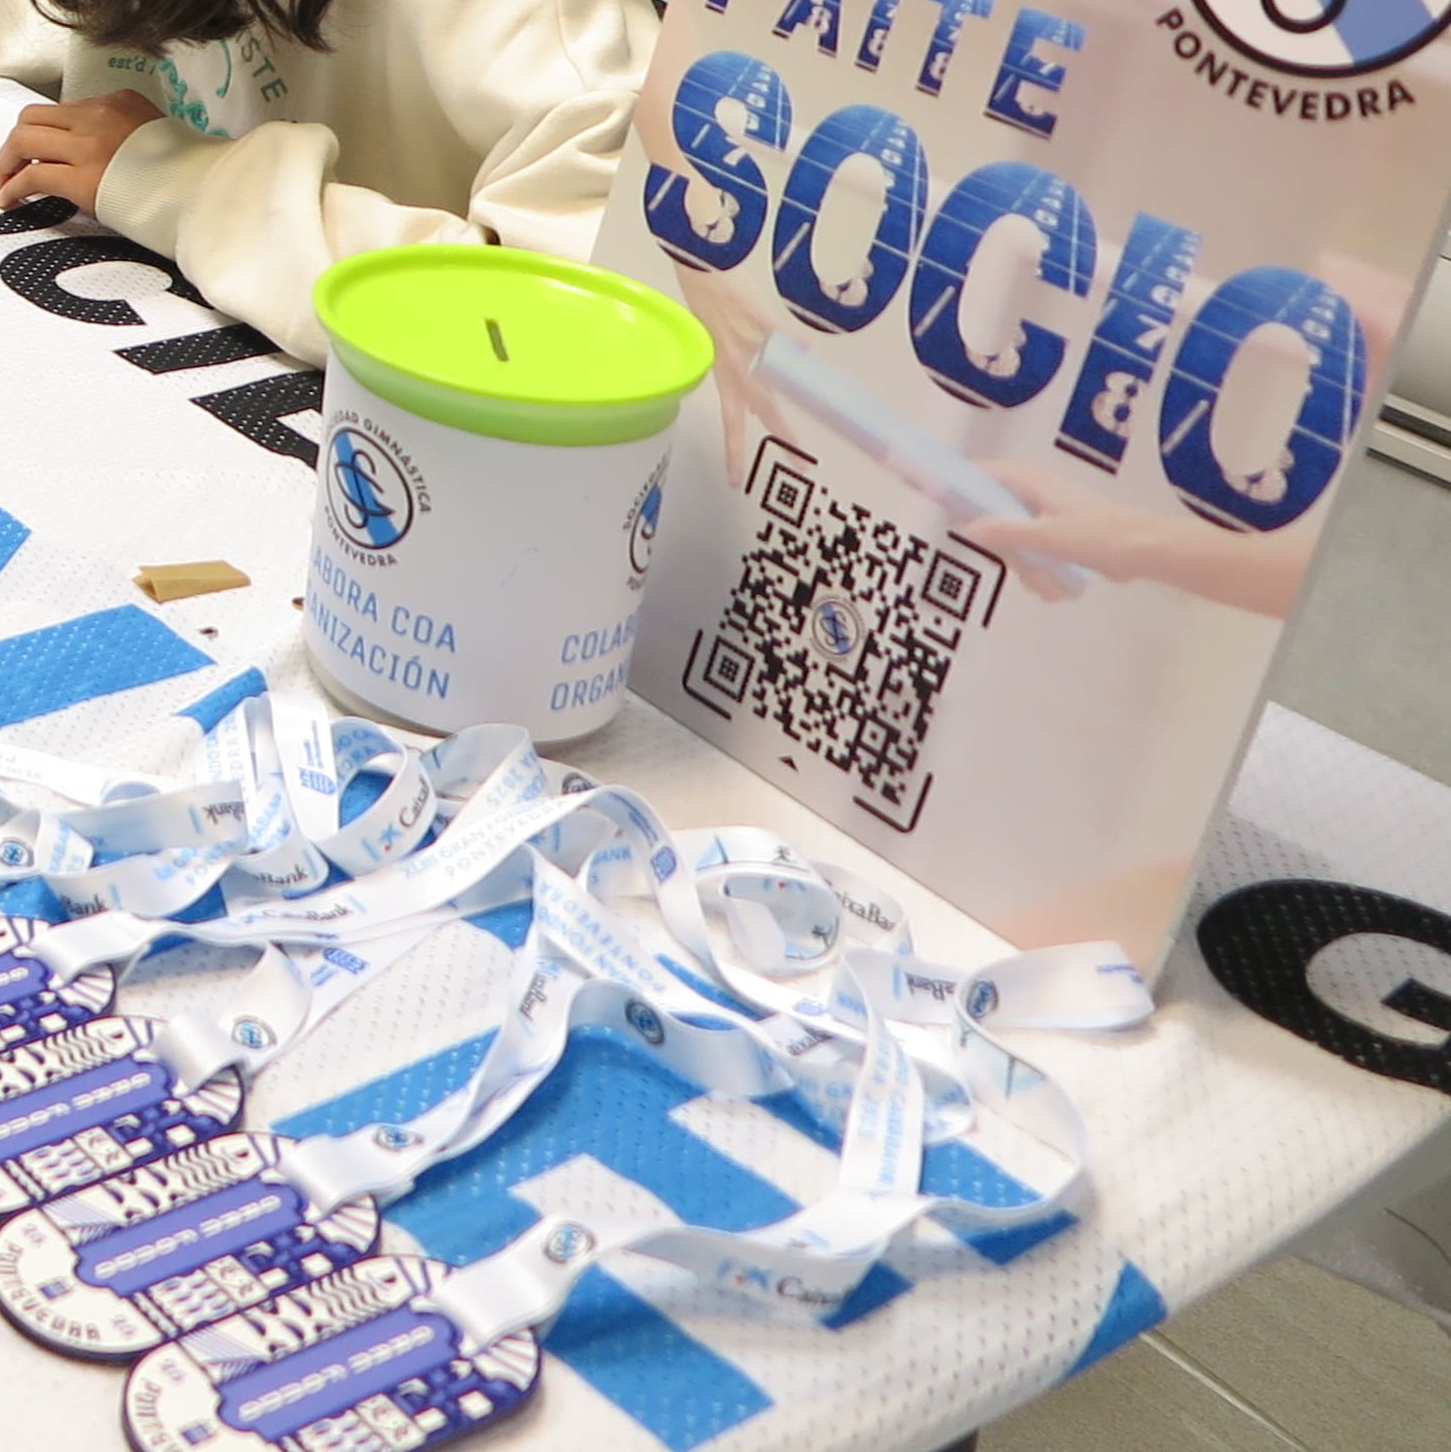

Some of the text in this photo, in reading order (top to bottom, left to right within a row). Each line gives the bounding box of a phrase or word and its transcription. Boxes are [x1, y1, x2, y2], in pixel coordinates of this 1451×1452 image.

[236, 28, 288, 102] STE
[1155, 8, 1416, 121] PONTEVEDRA
[642, 48, 1368, 534] SOCIO
[304, 591, 452, 701] ANIZACIÓN
[390, 605, 457, 655] COA
